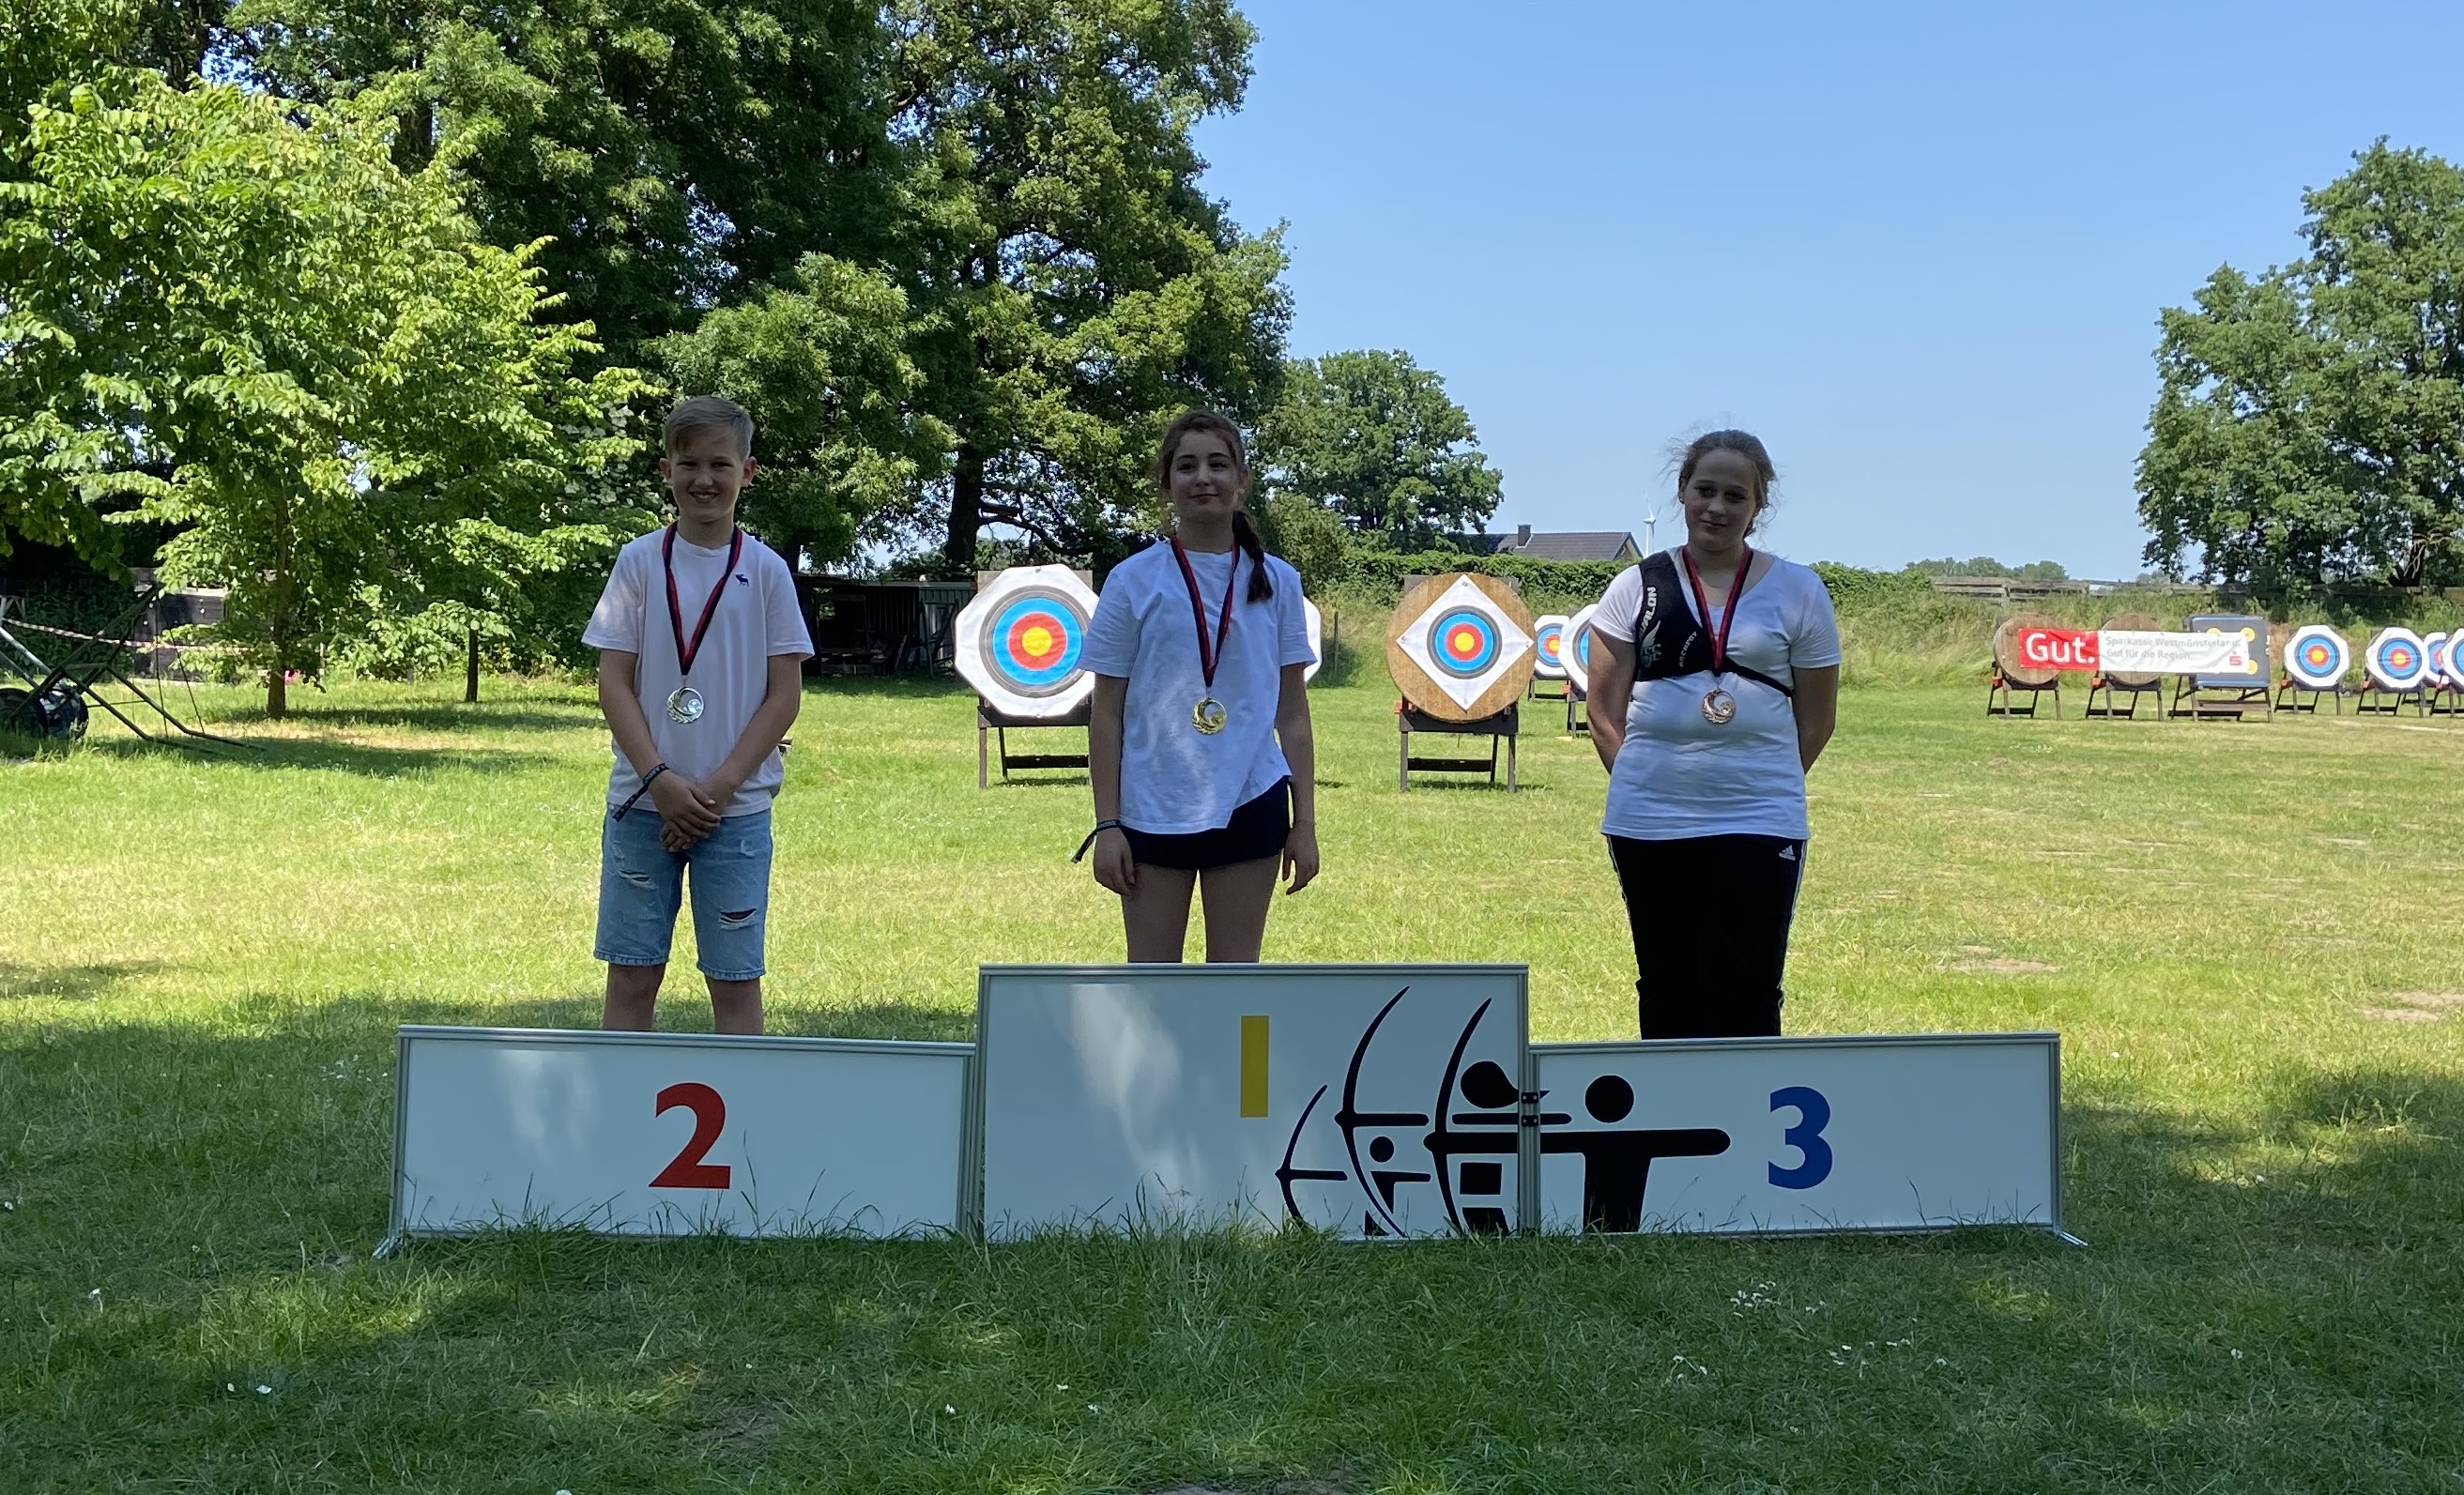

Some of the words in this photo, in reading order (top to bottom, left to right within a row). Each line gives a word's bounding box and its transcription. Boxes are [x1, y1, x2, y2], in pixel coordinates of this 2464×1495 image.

[2026, 633, 2095, 664] Gut.
[2105, 635, 2153, 647] Sparkasse
[2106, 648, 2123, 658] Gut
[2124, 648, 2139, 659] für
[2141, 649, 2155, 659] die
[648, 1082, 731, 1190] 2
[1768, 1086, 1833, 1190] 3
